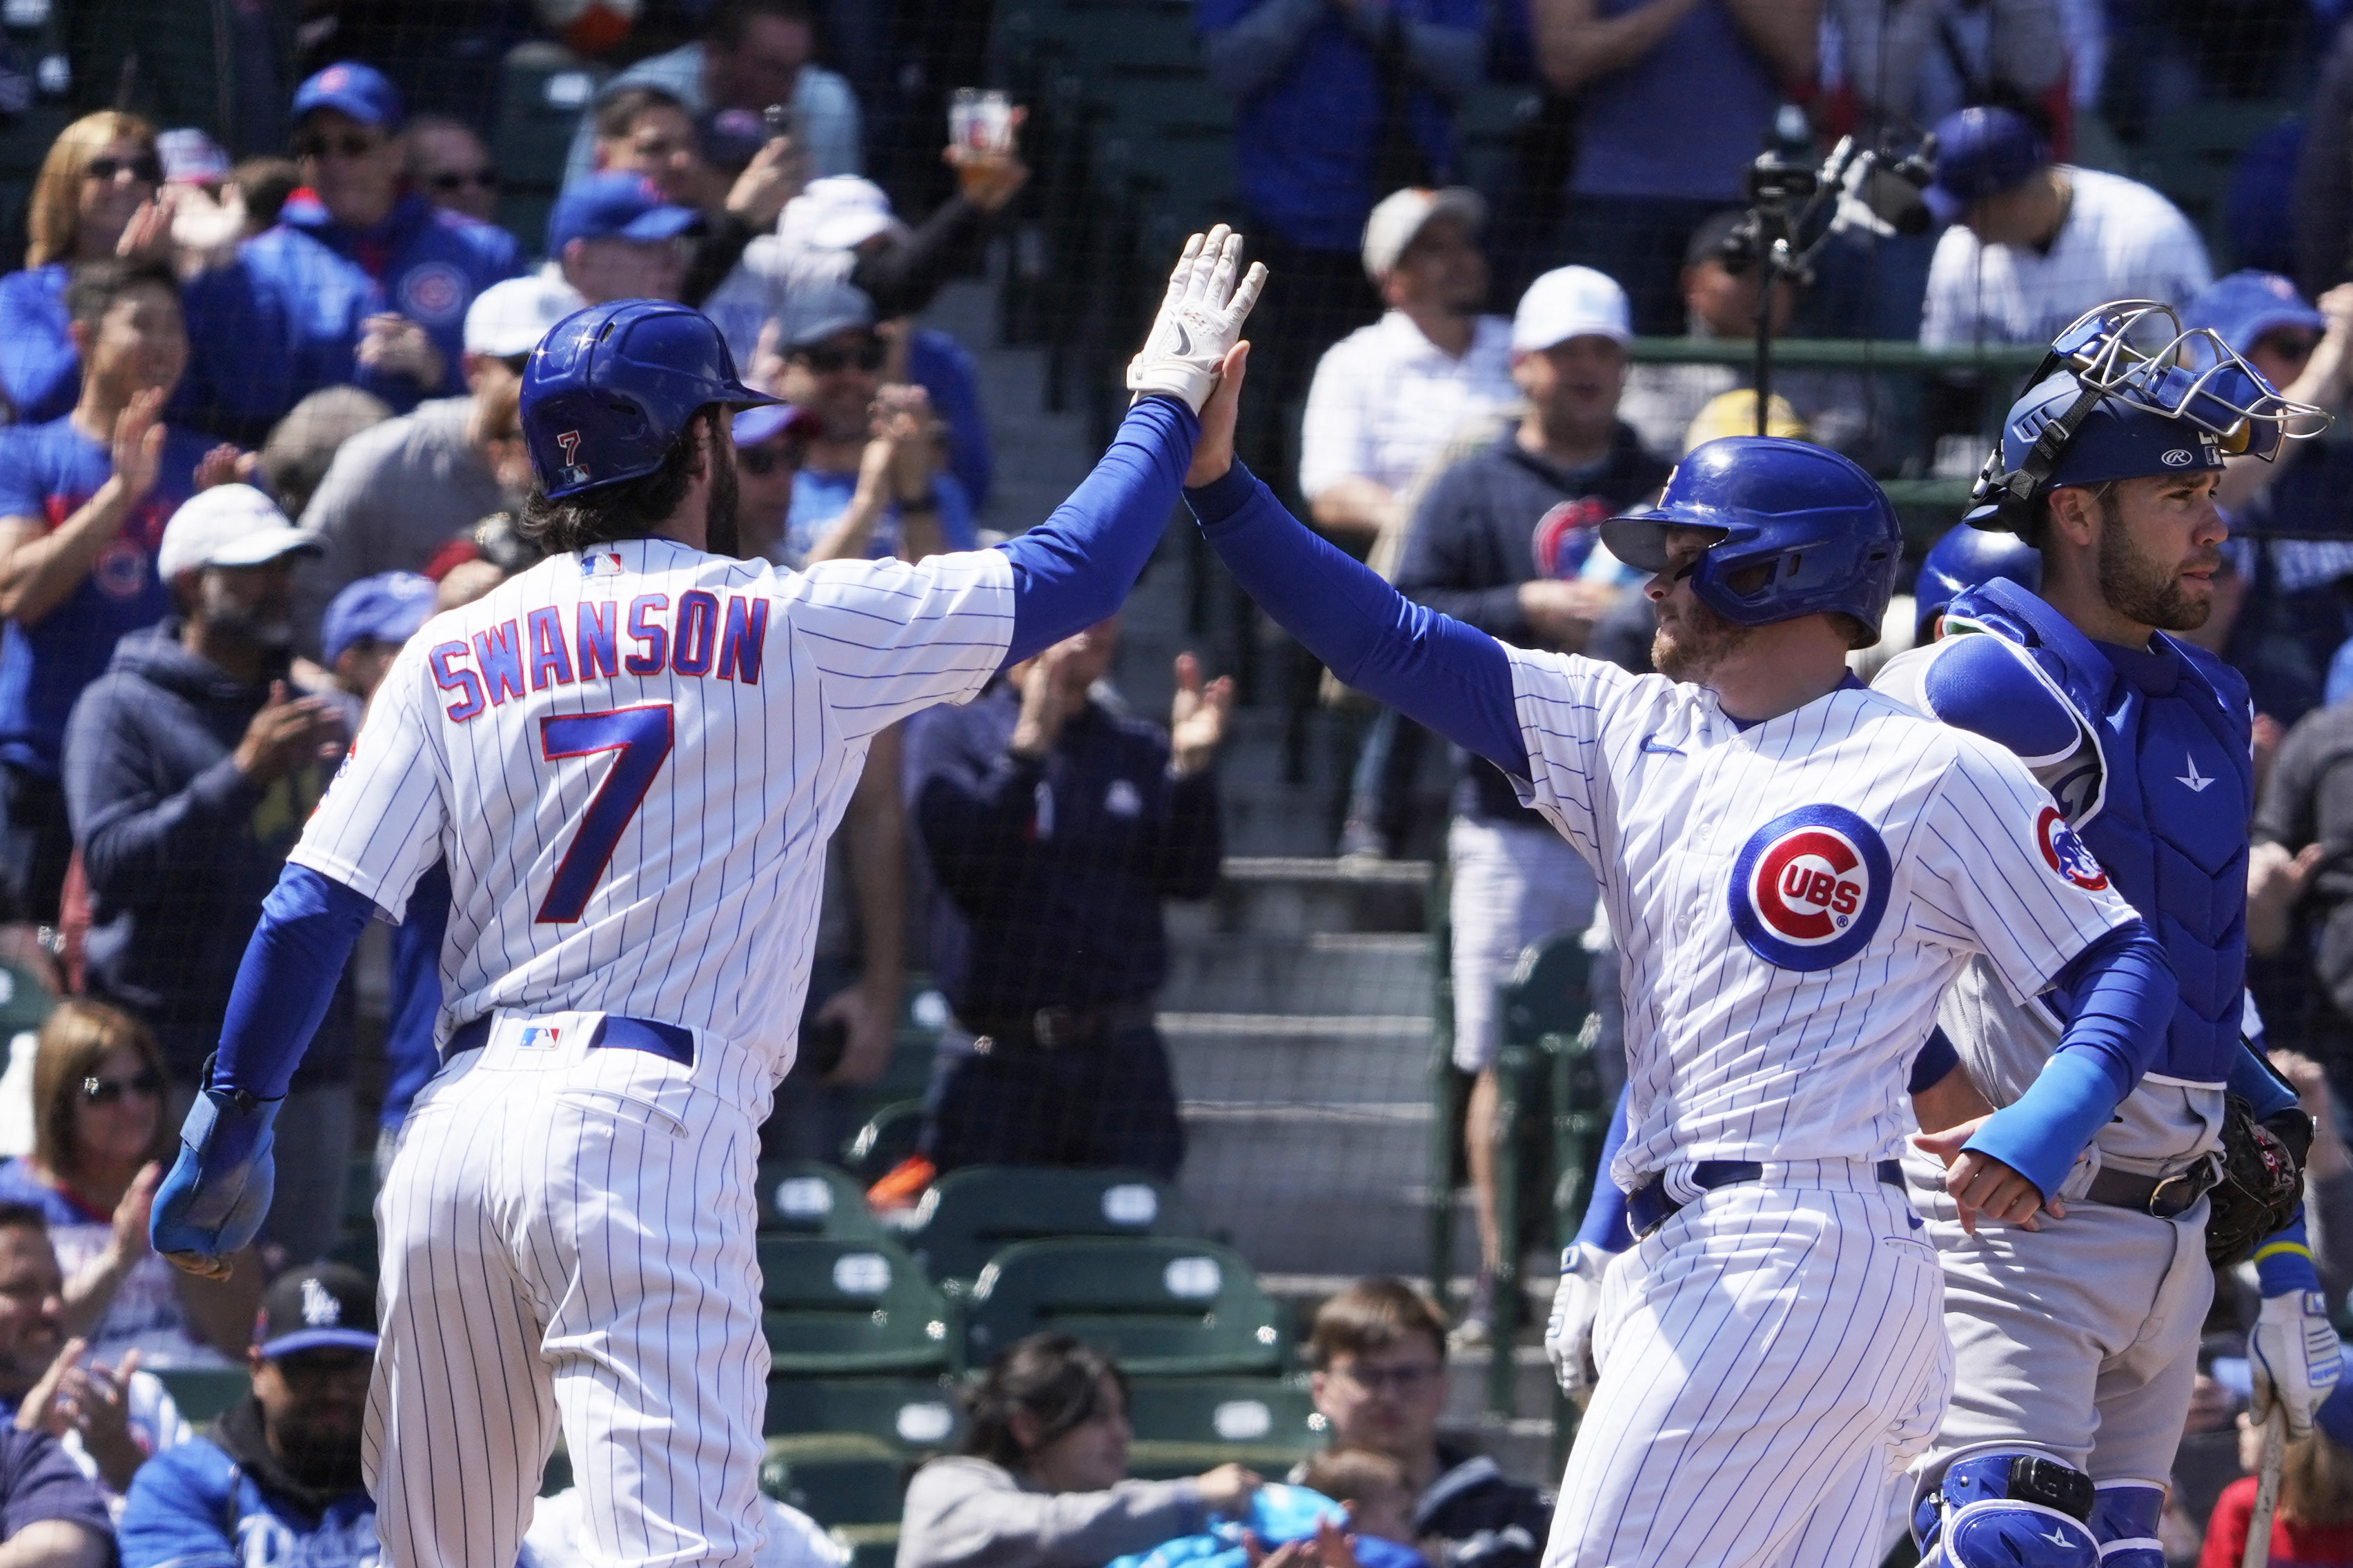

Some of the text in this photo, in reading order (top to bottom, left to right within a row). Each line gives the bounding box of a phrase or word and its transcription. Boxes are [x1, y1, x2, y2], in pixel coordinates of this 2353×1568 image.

[556, 429, 582, 467] 7
[428, 590, 770, 724] SWANSON
[534, 704, 674, 924] 7
